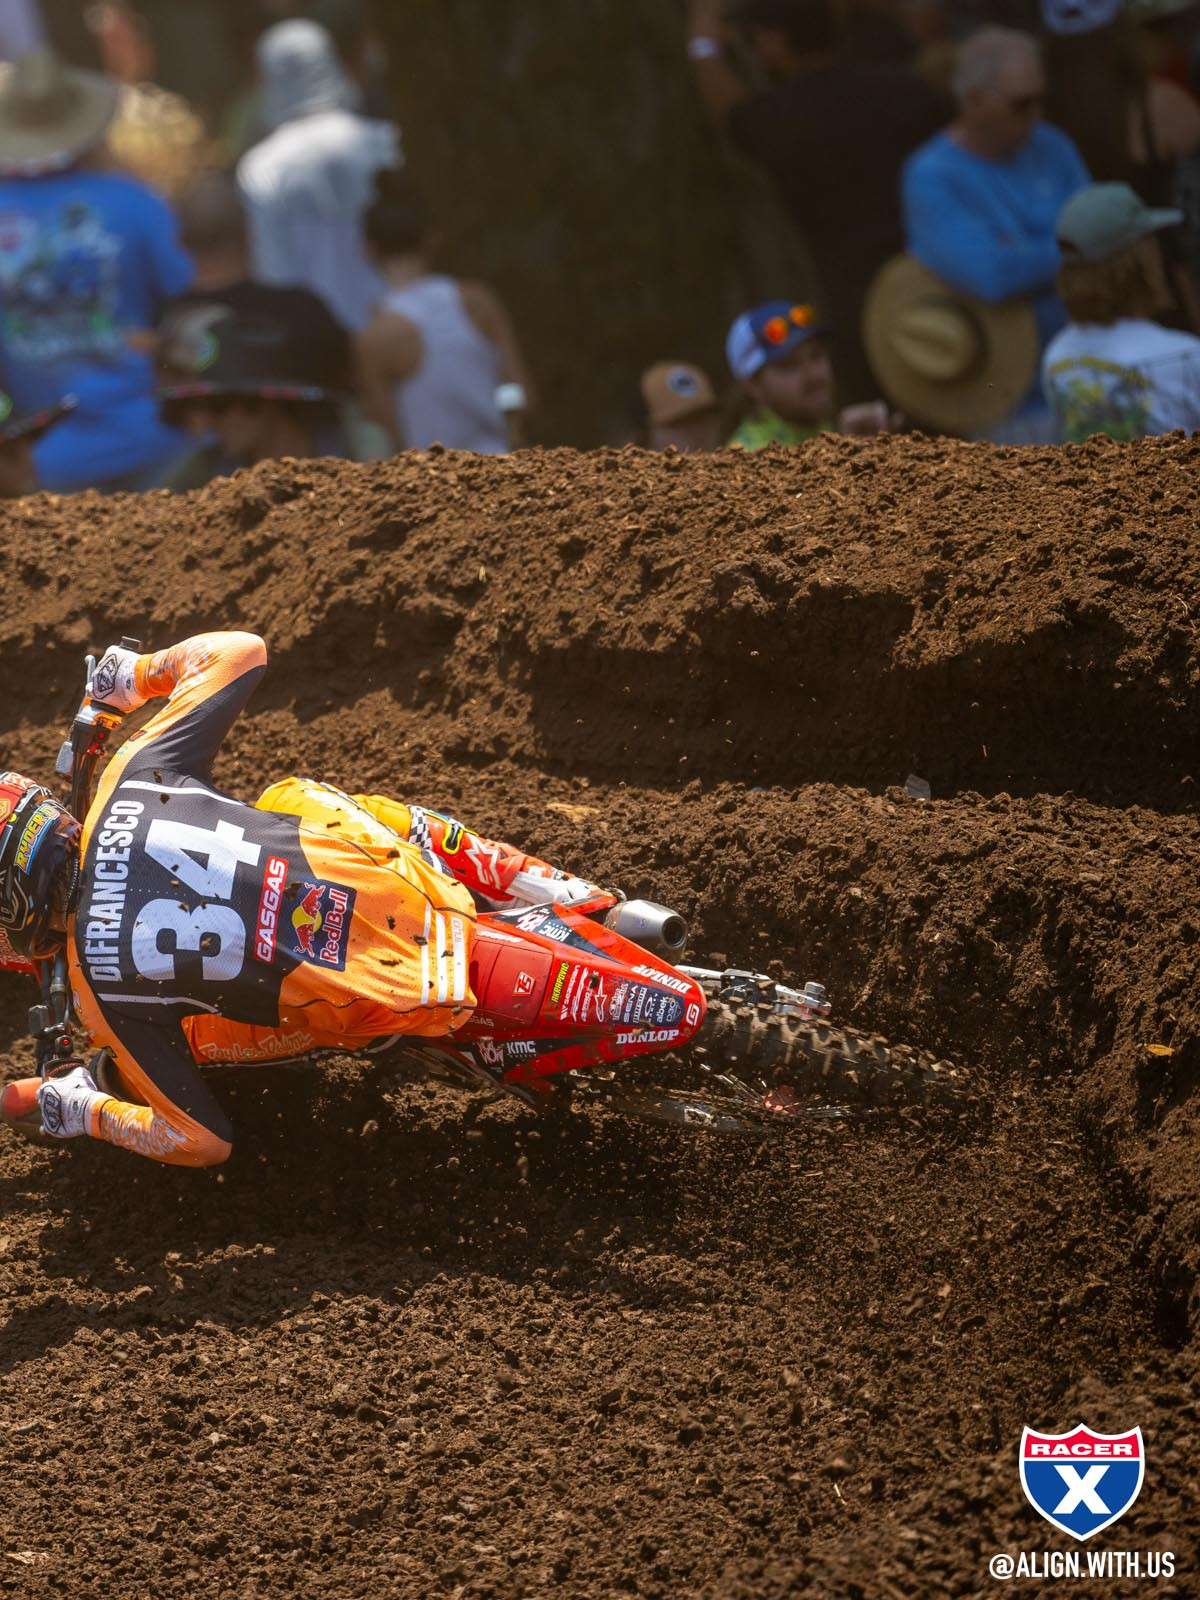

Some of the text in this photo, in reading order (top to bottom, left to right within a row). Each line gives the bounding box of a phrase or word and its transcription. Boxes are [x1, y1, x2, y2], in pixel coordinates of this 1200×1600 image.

[16, 812, 46, 868] RYDER
[83, 800, 144, 982] DIFRANCESCO
[131, 818, 261, 981] 34
[257, 859, 286, 963] GASGAS
[319, 888, 349, 964] Red Bull
[564, 964, 581, 1005] seaspan
[623, 985, 638, 1023] SENA
[631, 964, 693, 994] DUNLOP
[616, 1029, 680, 1044] DUNLOP
